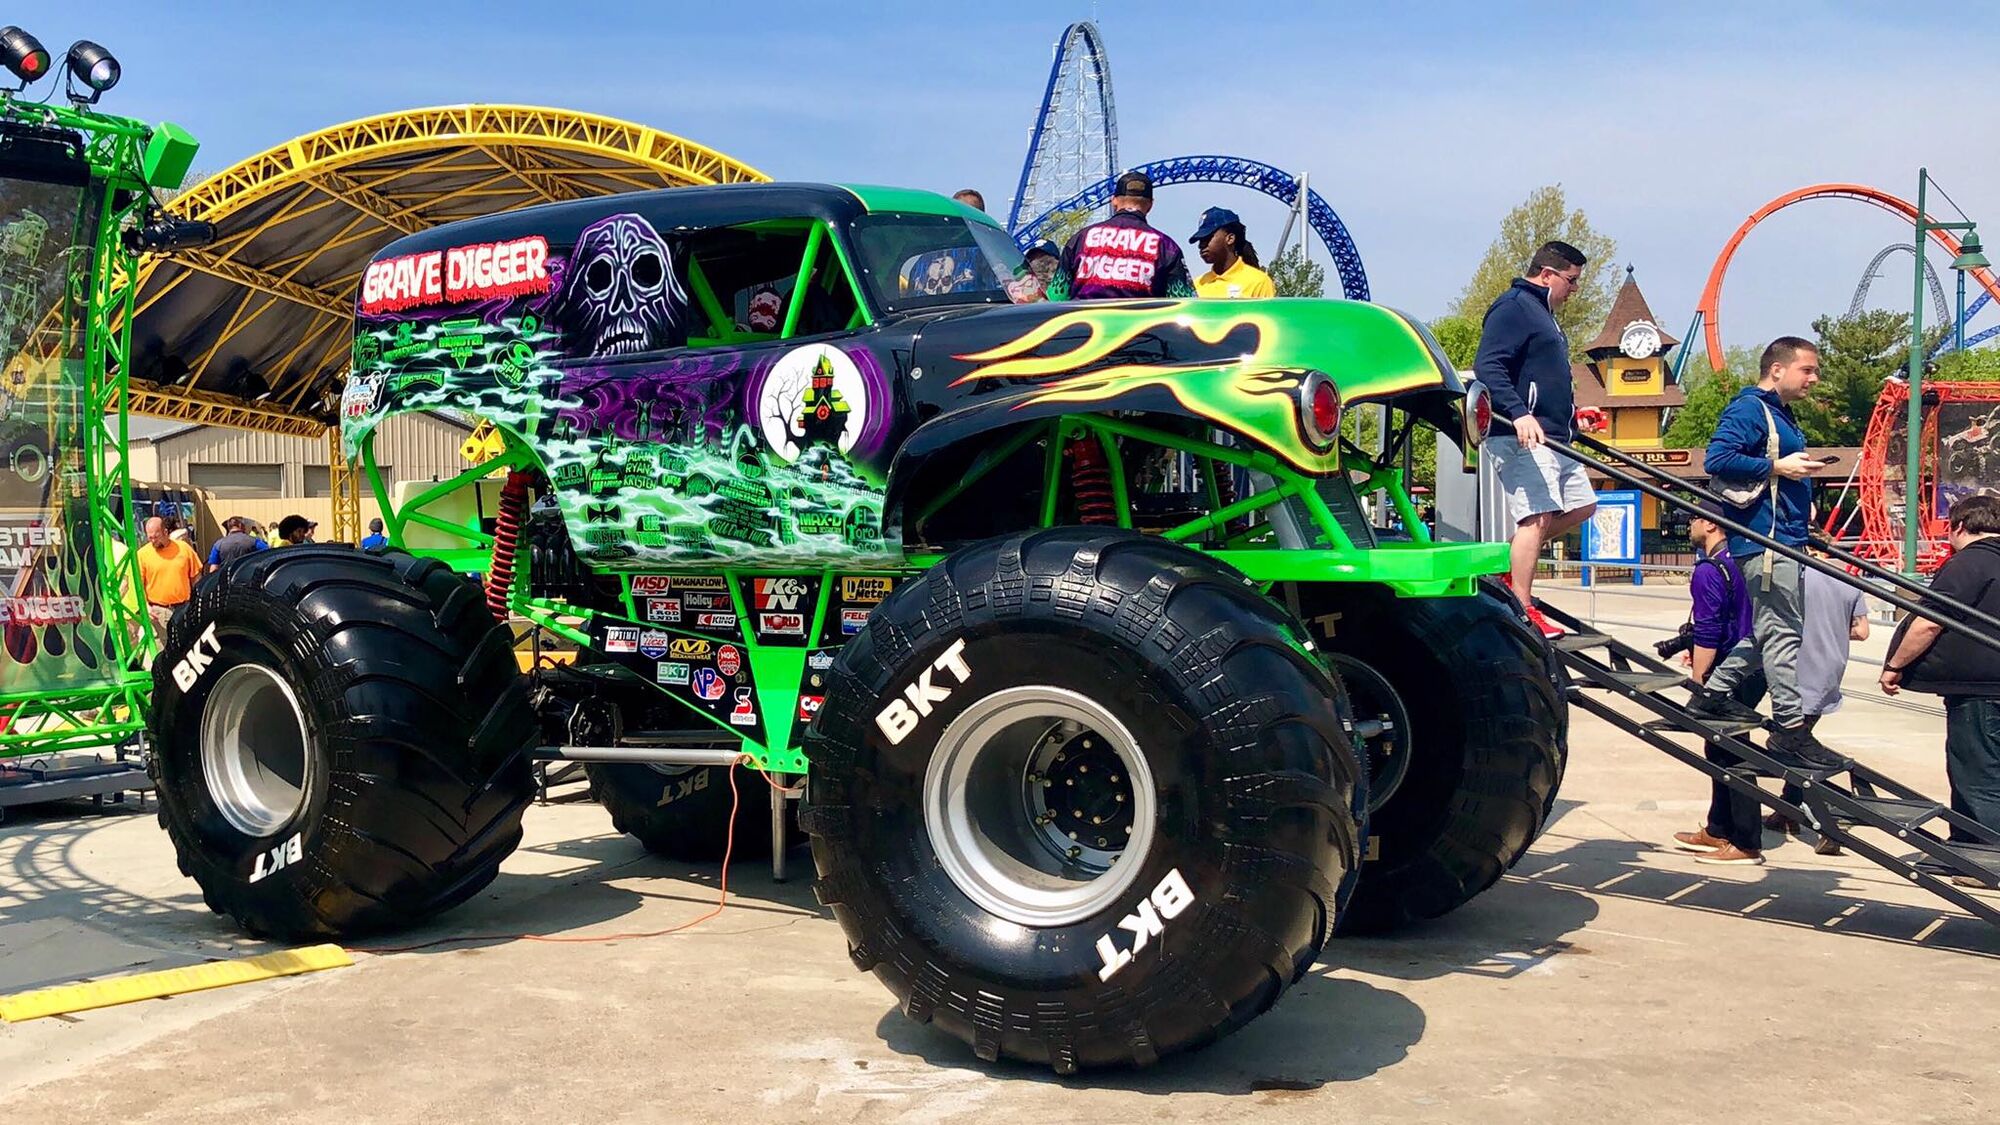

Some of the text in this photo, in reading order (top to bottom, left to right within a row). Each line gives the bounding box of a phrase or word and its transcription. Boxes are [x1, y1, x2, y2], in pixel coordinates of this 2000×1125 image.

[1086, 227, 1160, 254] GRAVE
[363, 238, 549, 303] GRAVE DIGGER
[1077, 256, 1155, 285] DIGGER
[498, 358, 524, 382] SPIN
[1646, 453, 1667, 462] RR
[556, 464, 583, 479] ALIEN
[715, 485, 773, 509] ANDERSON
[729, 480, 767, 496] DENNIS
[780, 488, 798, 546] ZOMBIE
[0, 527, 63, 546] STER
[855, 542, 877, 552] oco
[633, 576, 668, 590] MSD
[672, 577, 722, 587] MAGNAFLOW
[857, 579, 884, 589] Auto
[685, 593, 712, 608] Holley
[855, 589, 889, 599] Meter
[14, 596, 87, 620] DIGGER
[711, 616, 735, 625] KING
[609, 631, 637, 641] OPTIMA
[171, 621, 222, 694] BKT
[659, 663, 688, 679] BKT
[693, 667, 717, 699] VP
[875, 638, 972, 745] BKT
[656, 767, 710, 807] BKT
[249, 831, 303, 884] BKT
[1095, 868, 1196, 983] BKT
